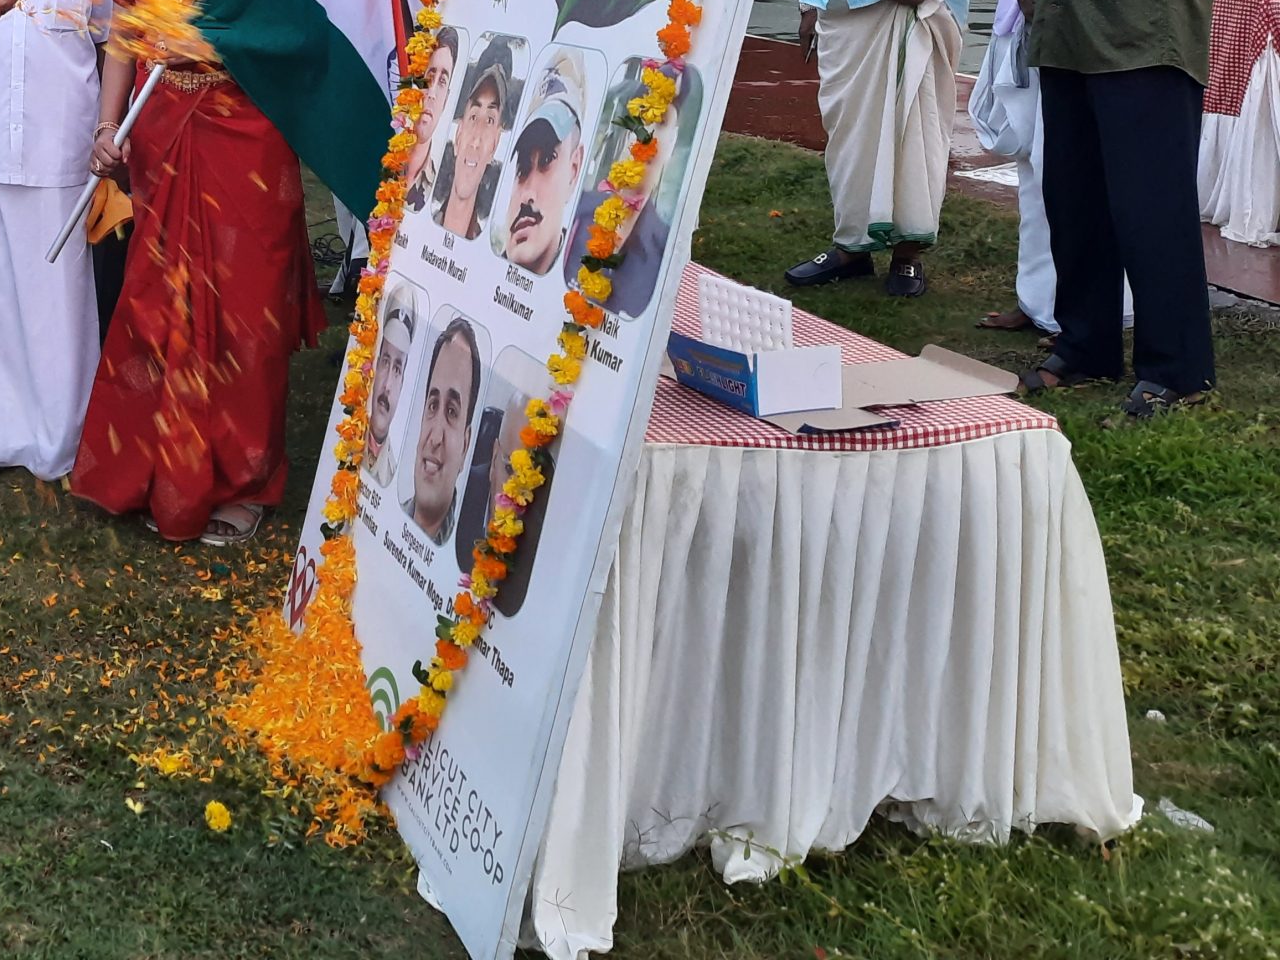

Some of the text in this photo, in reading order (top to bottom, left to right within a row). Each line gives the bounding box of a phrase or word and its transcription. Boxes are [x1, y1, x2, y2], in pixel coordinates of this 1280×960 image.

[446, 258, 468, 284] Murali
[504, 264, 534, 295] Rifleman
[493, 285, 535, 322] Sunilkumar
[600, 313, 621, 340] Naik
[589, 338, 624, 373] Kumar
[401, 522, 425, 560] Sergeant
[383, 530, 443, 611] Surendra Kumar Moga
[489, 645, 515, 689] Thapa
[401, 755, 460, 861] BANK LTD.
[424, 730, 503, 849] LICUT CITY
[461, 814, 504, 886] CO-OP
